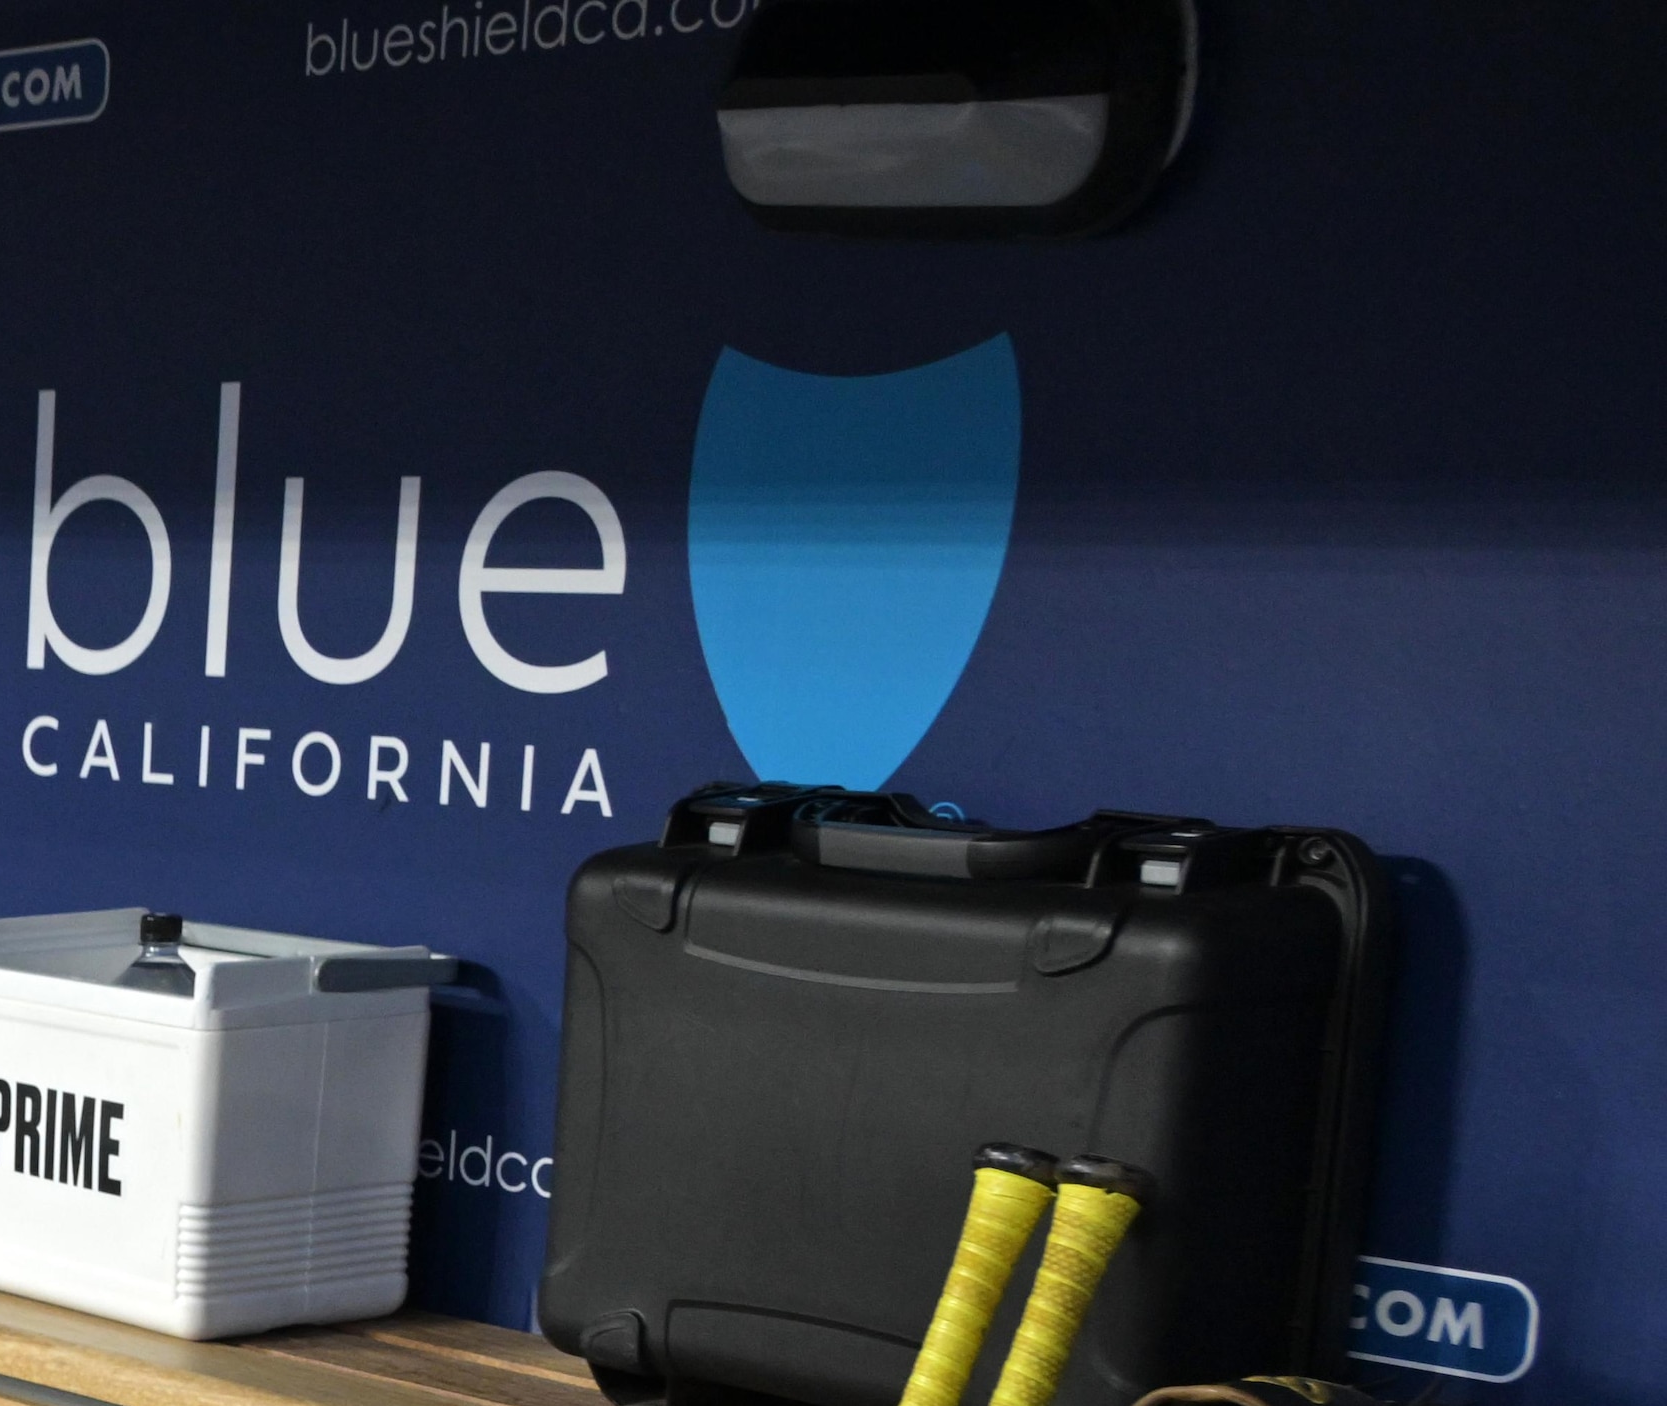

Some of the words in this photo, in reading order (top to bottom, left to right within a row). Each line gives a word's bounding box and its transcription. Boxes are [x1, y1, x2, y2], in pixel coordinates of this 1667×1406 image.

[305, 0, 761, 77] blueshieldca.co
[26, 381, 628, 695] blue
[20, 715, 615, 819] CALIFORNIA
